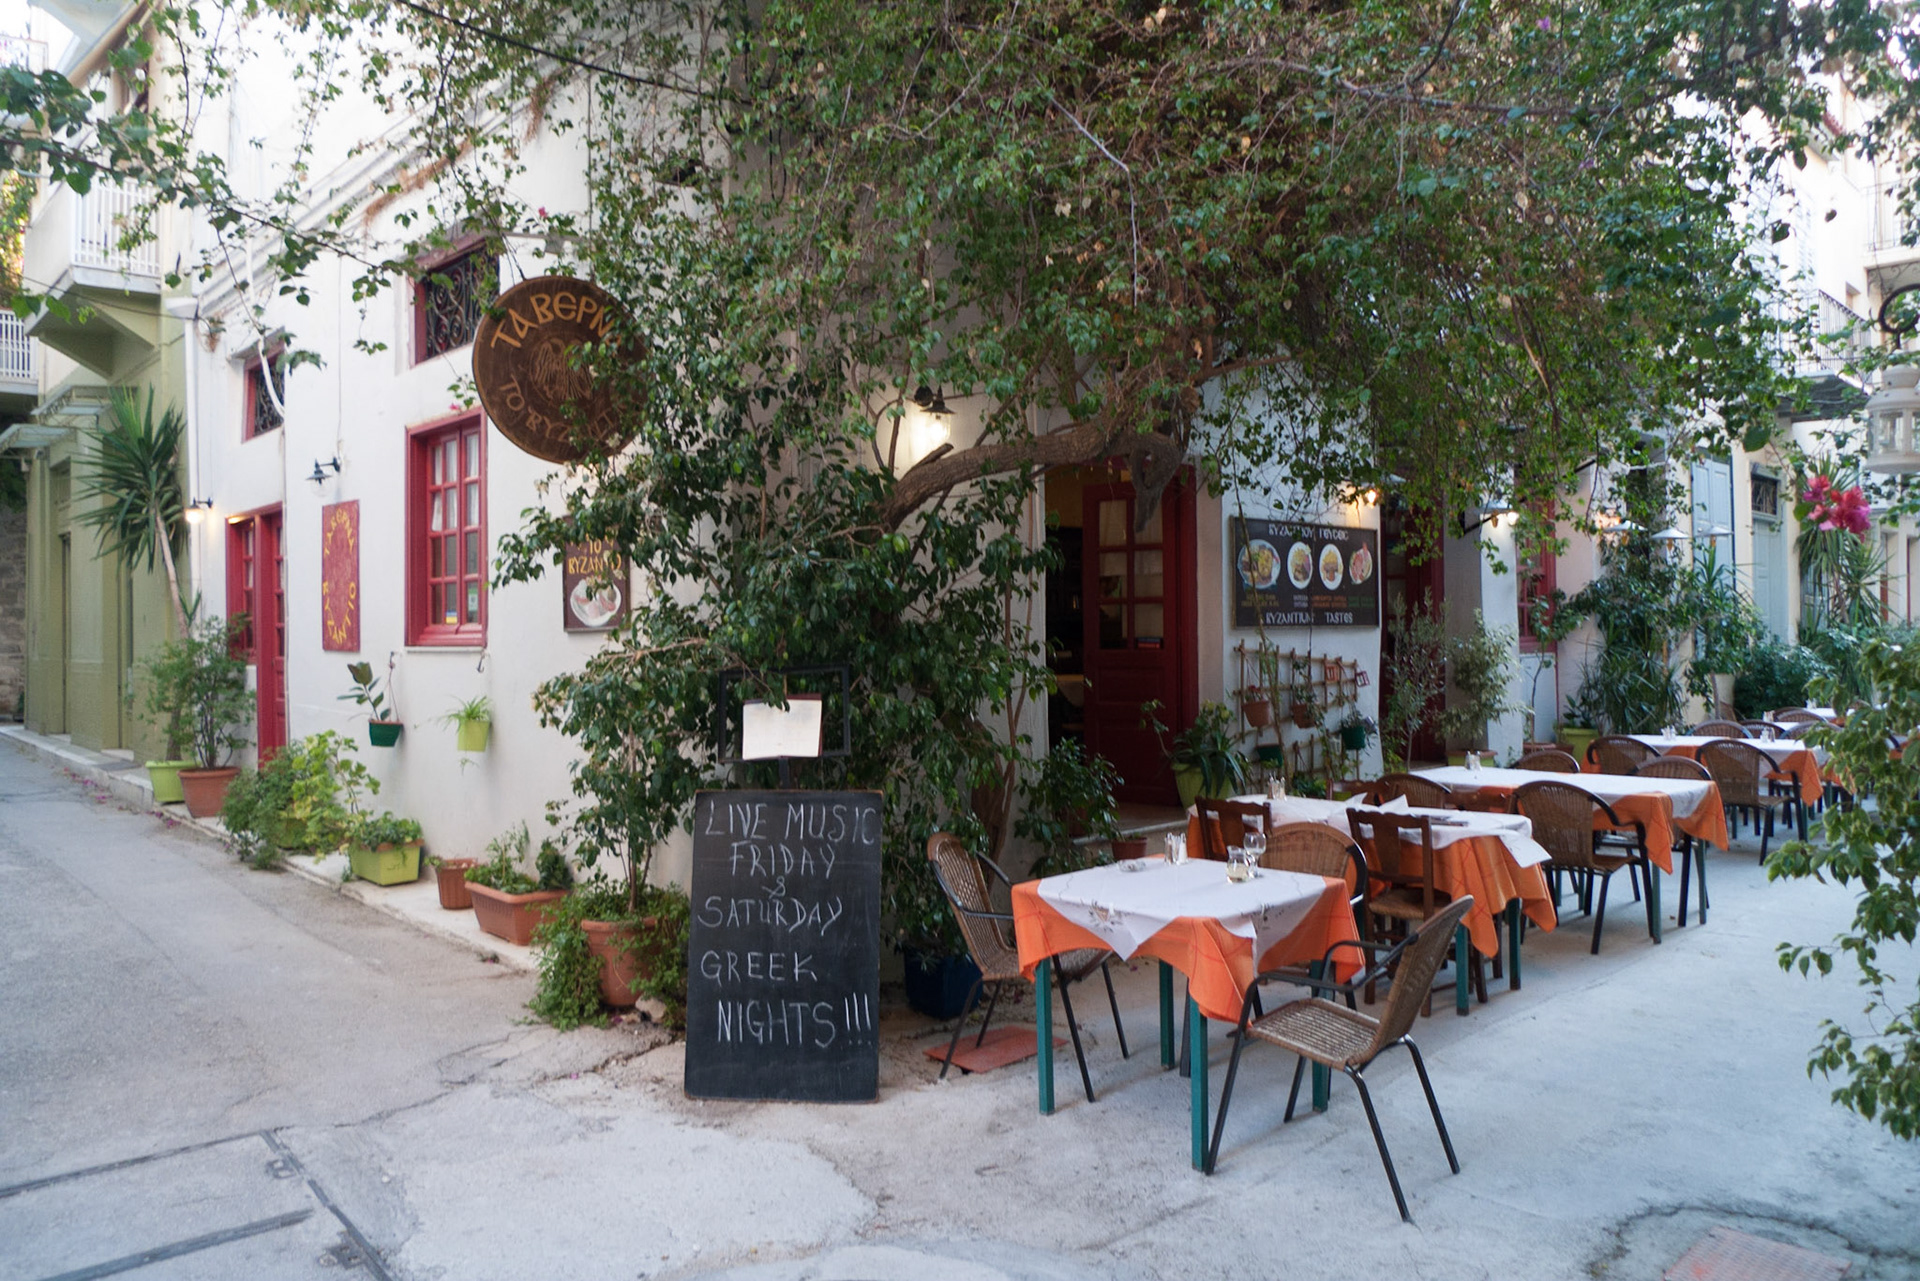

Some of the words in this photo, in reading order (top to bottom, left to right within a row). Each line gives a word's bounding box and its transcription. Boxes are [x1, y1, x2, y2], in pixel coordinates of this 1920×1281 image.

[490, 291, 621, 348] ΤΑΒΕΡΝ
[705, 800, 767, 840] LIVE
[784, 802, 876, 845] MUSIC
[730, 840, 835, 879] FRIDAY
[697, 896, 843, 936] SATURDAY
[701, 950, 818, 987] GREEK
